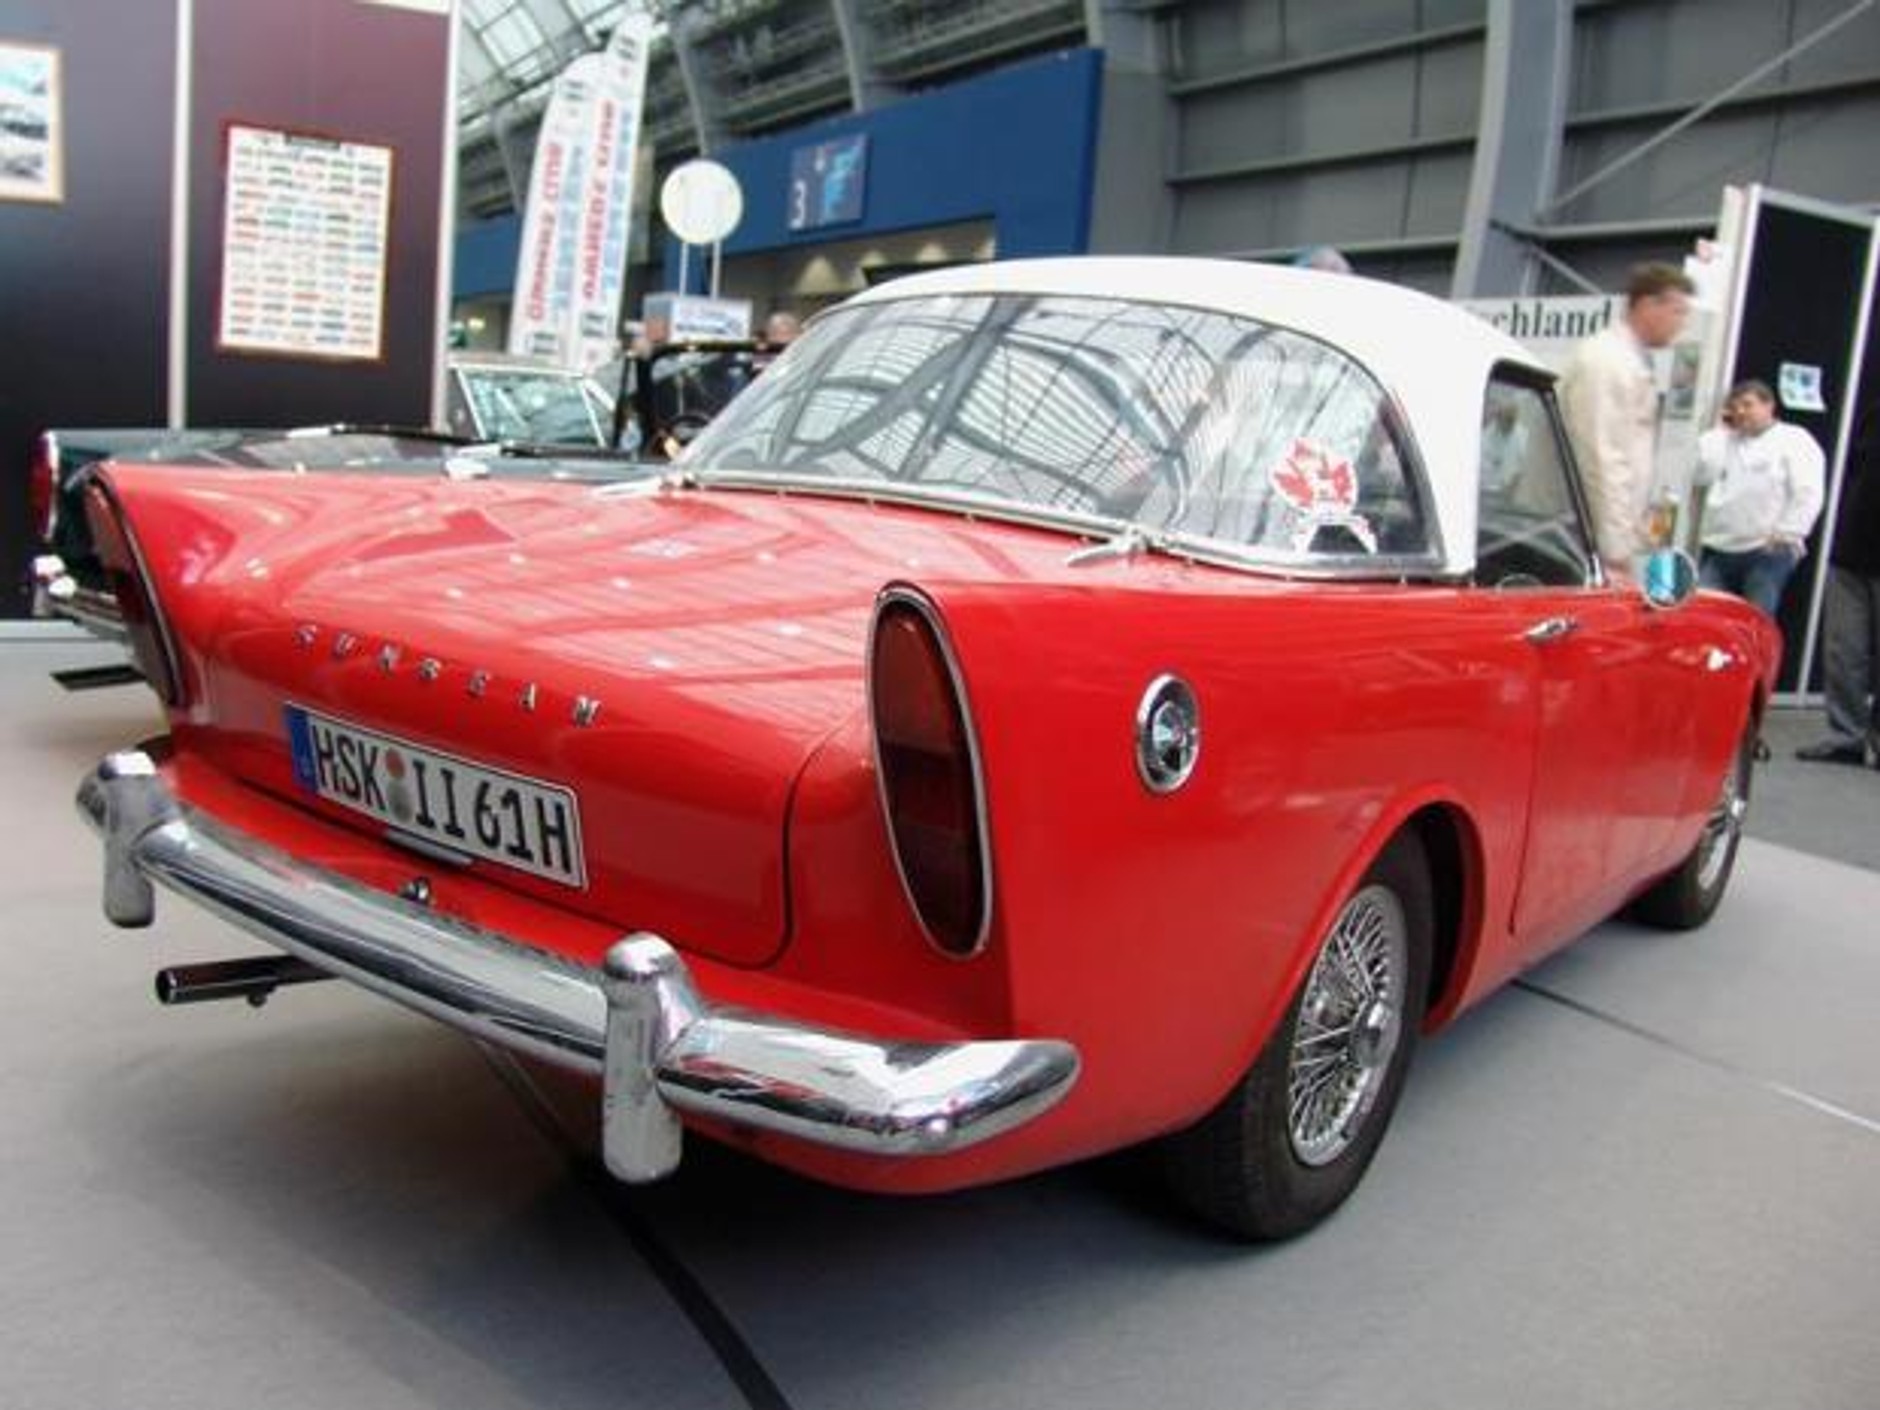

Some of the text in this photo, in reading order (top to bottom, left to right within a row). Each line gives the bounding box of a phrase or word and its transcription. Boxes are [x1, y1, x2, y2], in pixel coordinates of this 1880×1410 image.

[1479, 300, 1612, 337] chland
[298, 624, 600, 726] SUNBEAM
[312, 725, 386, 810] HSK
